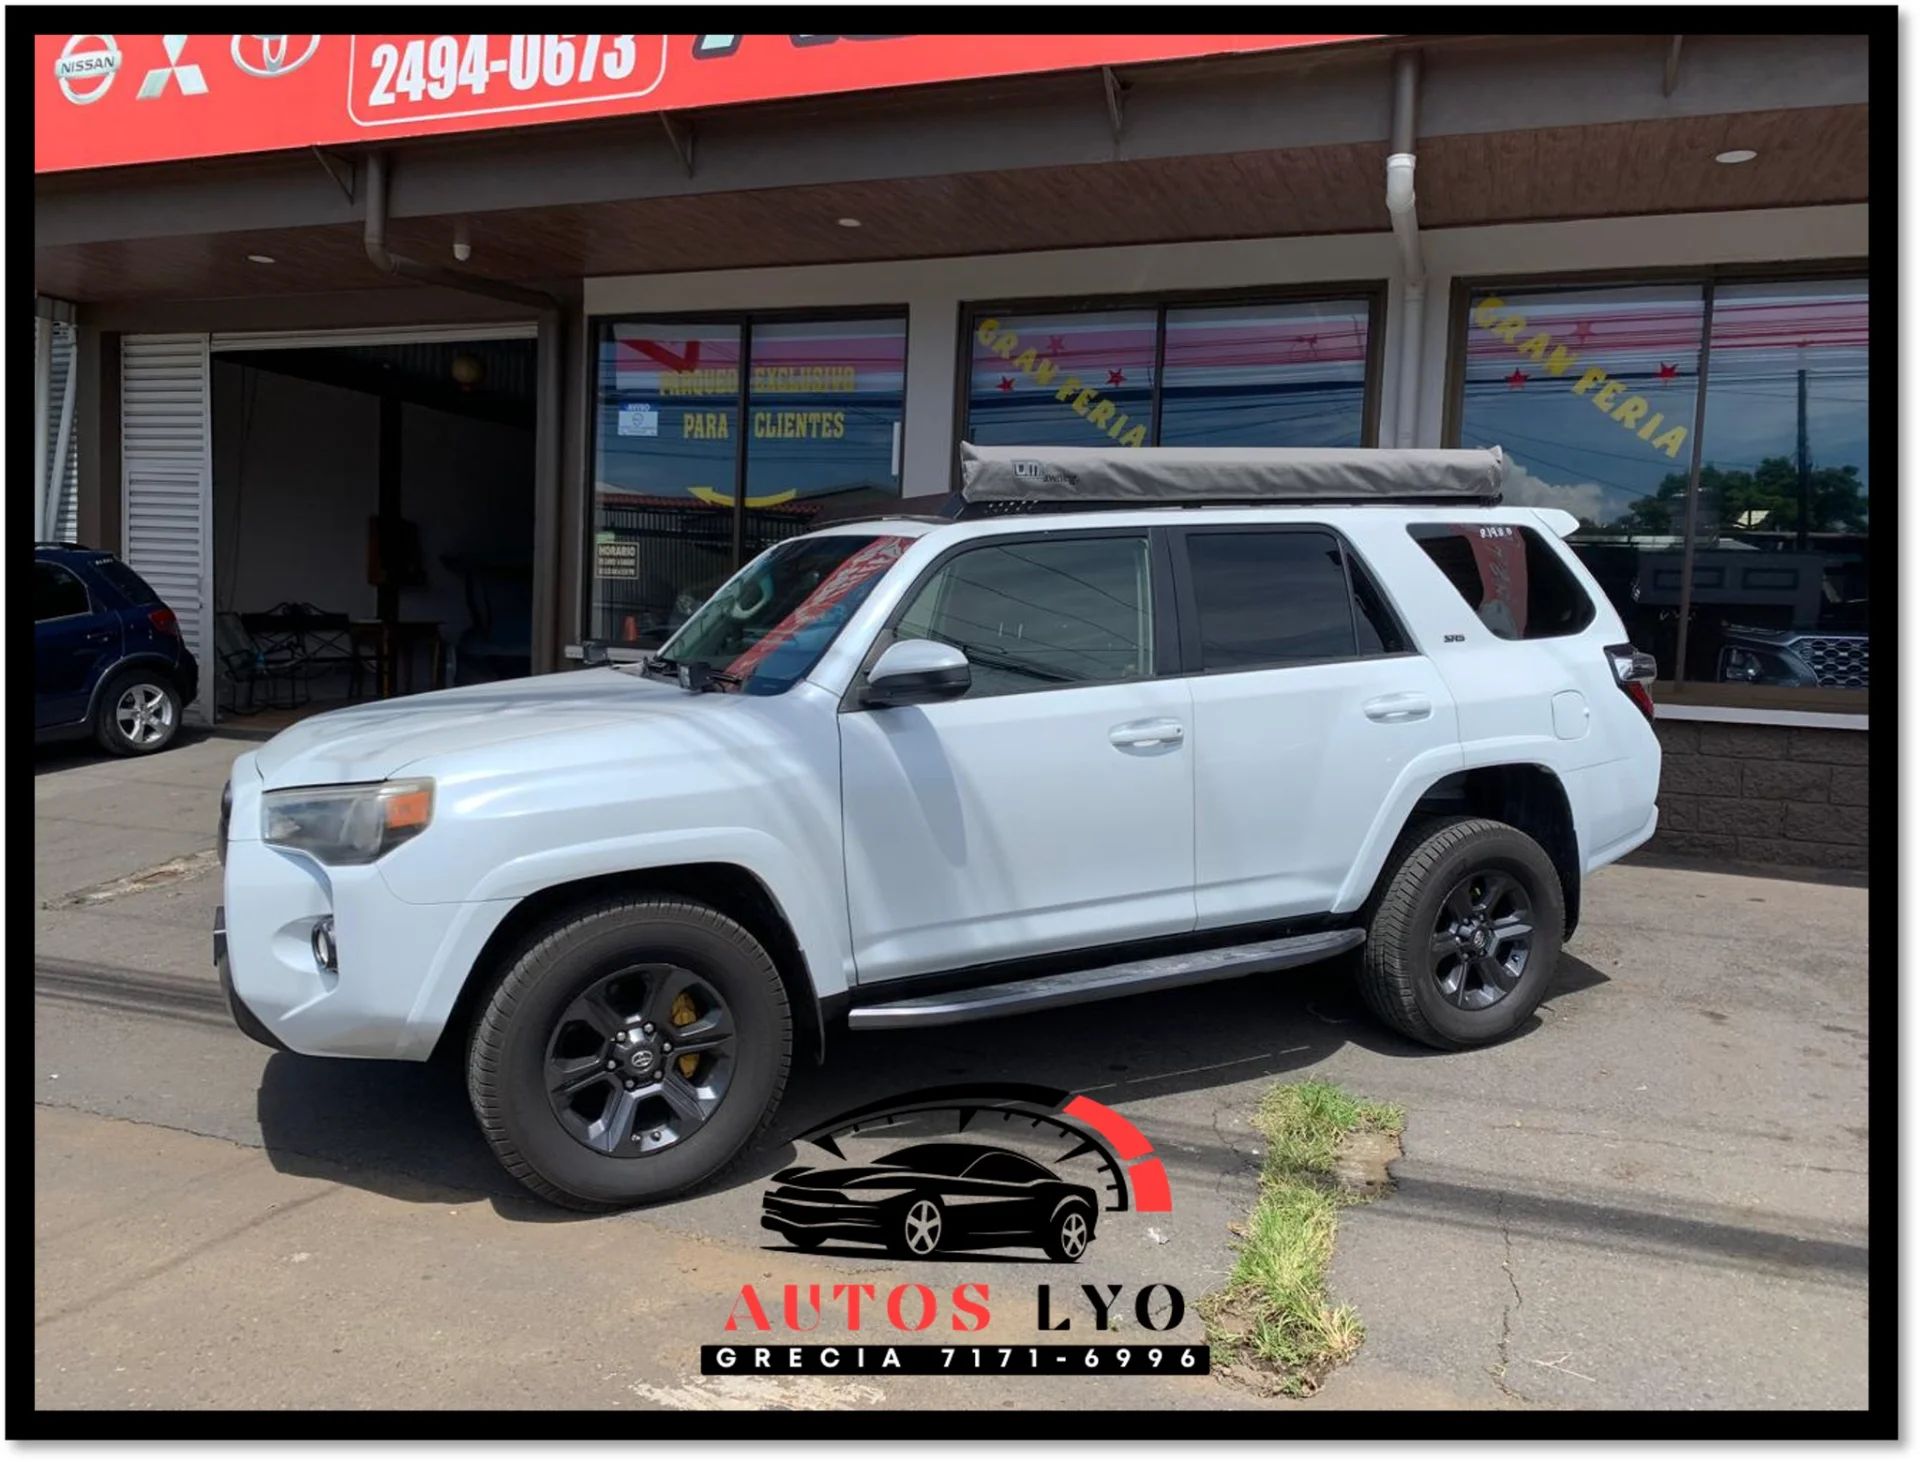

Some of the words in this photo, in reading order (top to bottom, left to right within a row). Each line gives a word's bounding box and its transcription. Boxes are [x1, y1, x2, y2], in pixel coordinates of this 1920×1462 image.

[61, 56, 115, 74] NISSAN
[368, 34, 636, 106] 2494-0673
[755, 366, 856, 393] EXCLUSIVO
[977, 318, 1059, 386] GRAN
[1055, 377, 1147, 447] FERIA
[1475, 295, 1578, 376] GRAN
[1571, 367, 1688, 458] FERIA
[684, 413, 729, 439] PARA
[755, 412, 844, 439] CLIENTES
